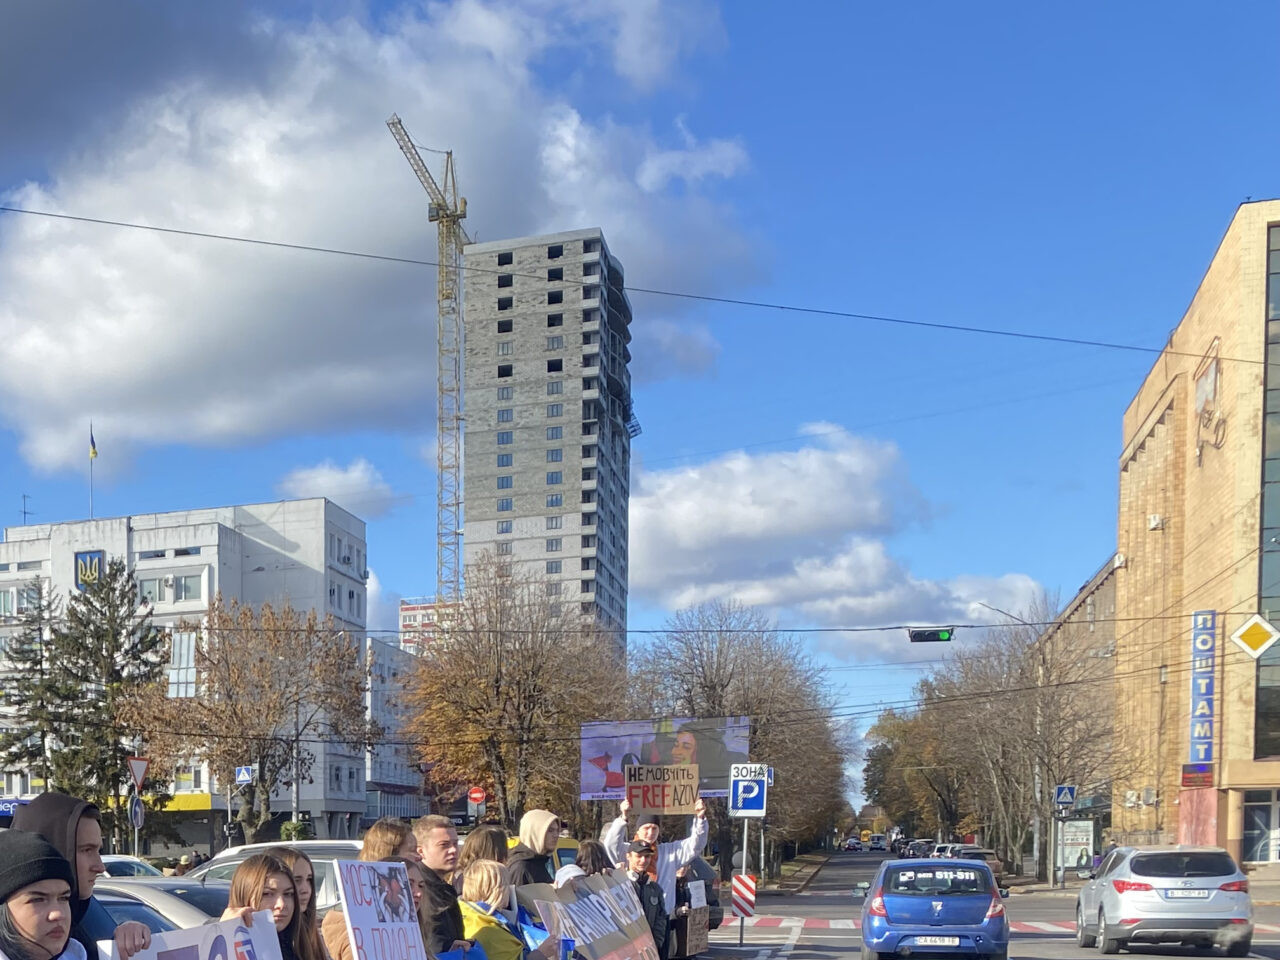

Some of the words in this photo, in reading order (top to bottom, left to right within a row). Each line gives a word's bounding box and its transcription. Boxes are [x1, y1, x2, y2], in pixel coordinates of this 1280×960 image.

[1193, 614, 1212, 759] ПОШТАМТ
[628, 767, 644, 782] НЕ
[646, 768, 694, 782] МОВЧІТЬ
[733, 766, 765, 777] ЗОНА
[628, 784, 671, 809] FREE
[673, 784, 700, 806] AZOV
[935, 871, 975, 880] 511-511
